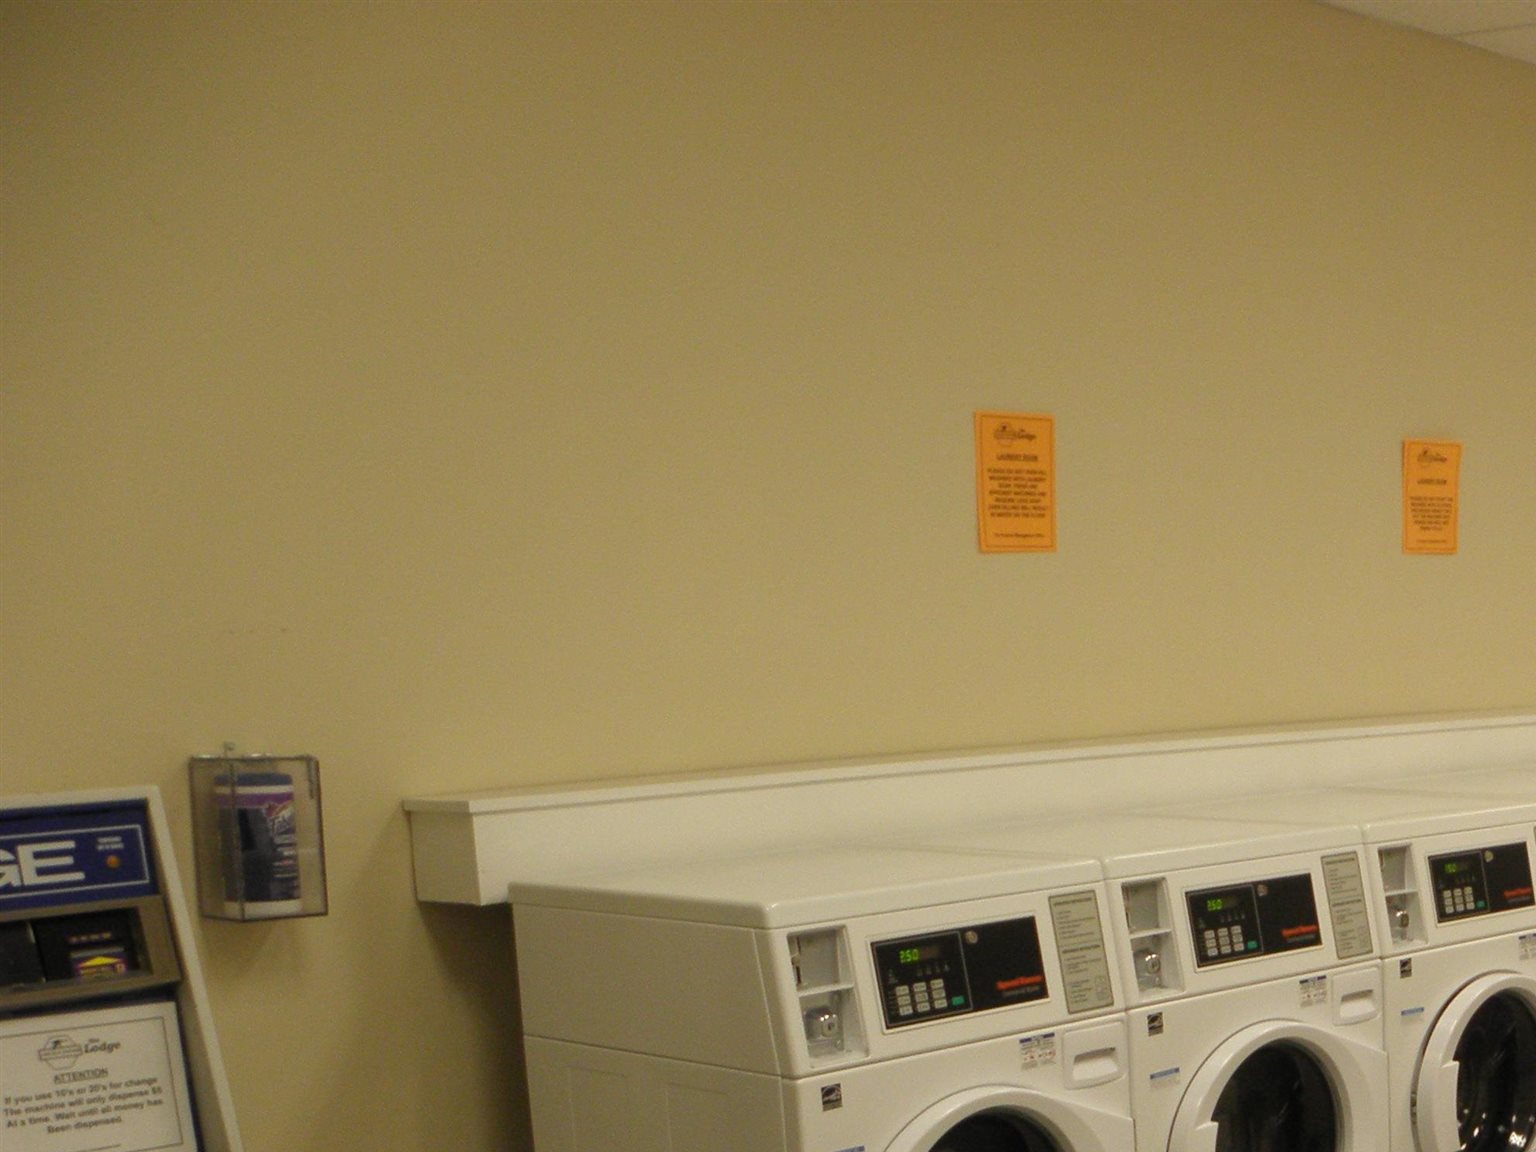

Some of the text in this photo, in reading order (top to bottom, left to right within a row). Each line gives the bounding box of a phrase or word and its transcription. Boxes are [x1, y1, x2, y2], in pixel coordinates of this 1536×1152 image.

[84, 1042, 120, 1054] Lodge
[54, 1068, 108, 1084] ATTENTION
[15, 1096, 32, 1106] you
[35, 1092, 52, 1100] use
[124, 1078, 157, 1087] change
[4, 1108, 21, 1116] The
[25, 1102, 65, 1113] machine
[68, 1098, 83, 1106] will
[86, 1095, 105, 1104] only
[108, 1090, 149, 1101] dispense
[7, 1120, 17, 1128] At
[55, 1112, 76, 1120] Wait
[78, 1108, 99, 1117] until
[101, 1105, 112, 1113] all
[114, 1103, 144, 1111] money
[47, 1125, 72, 1133] Been
